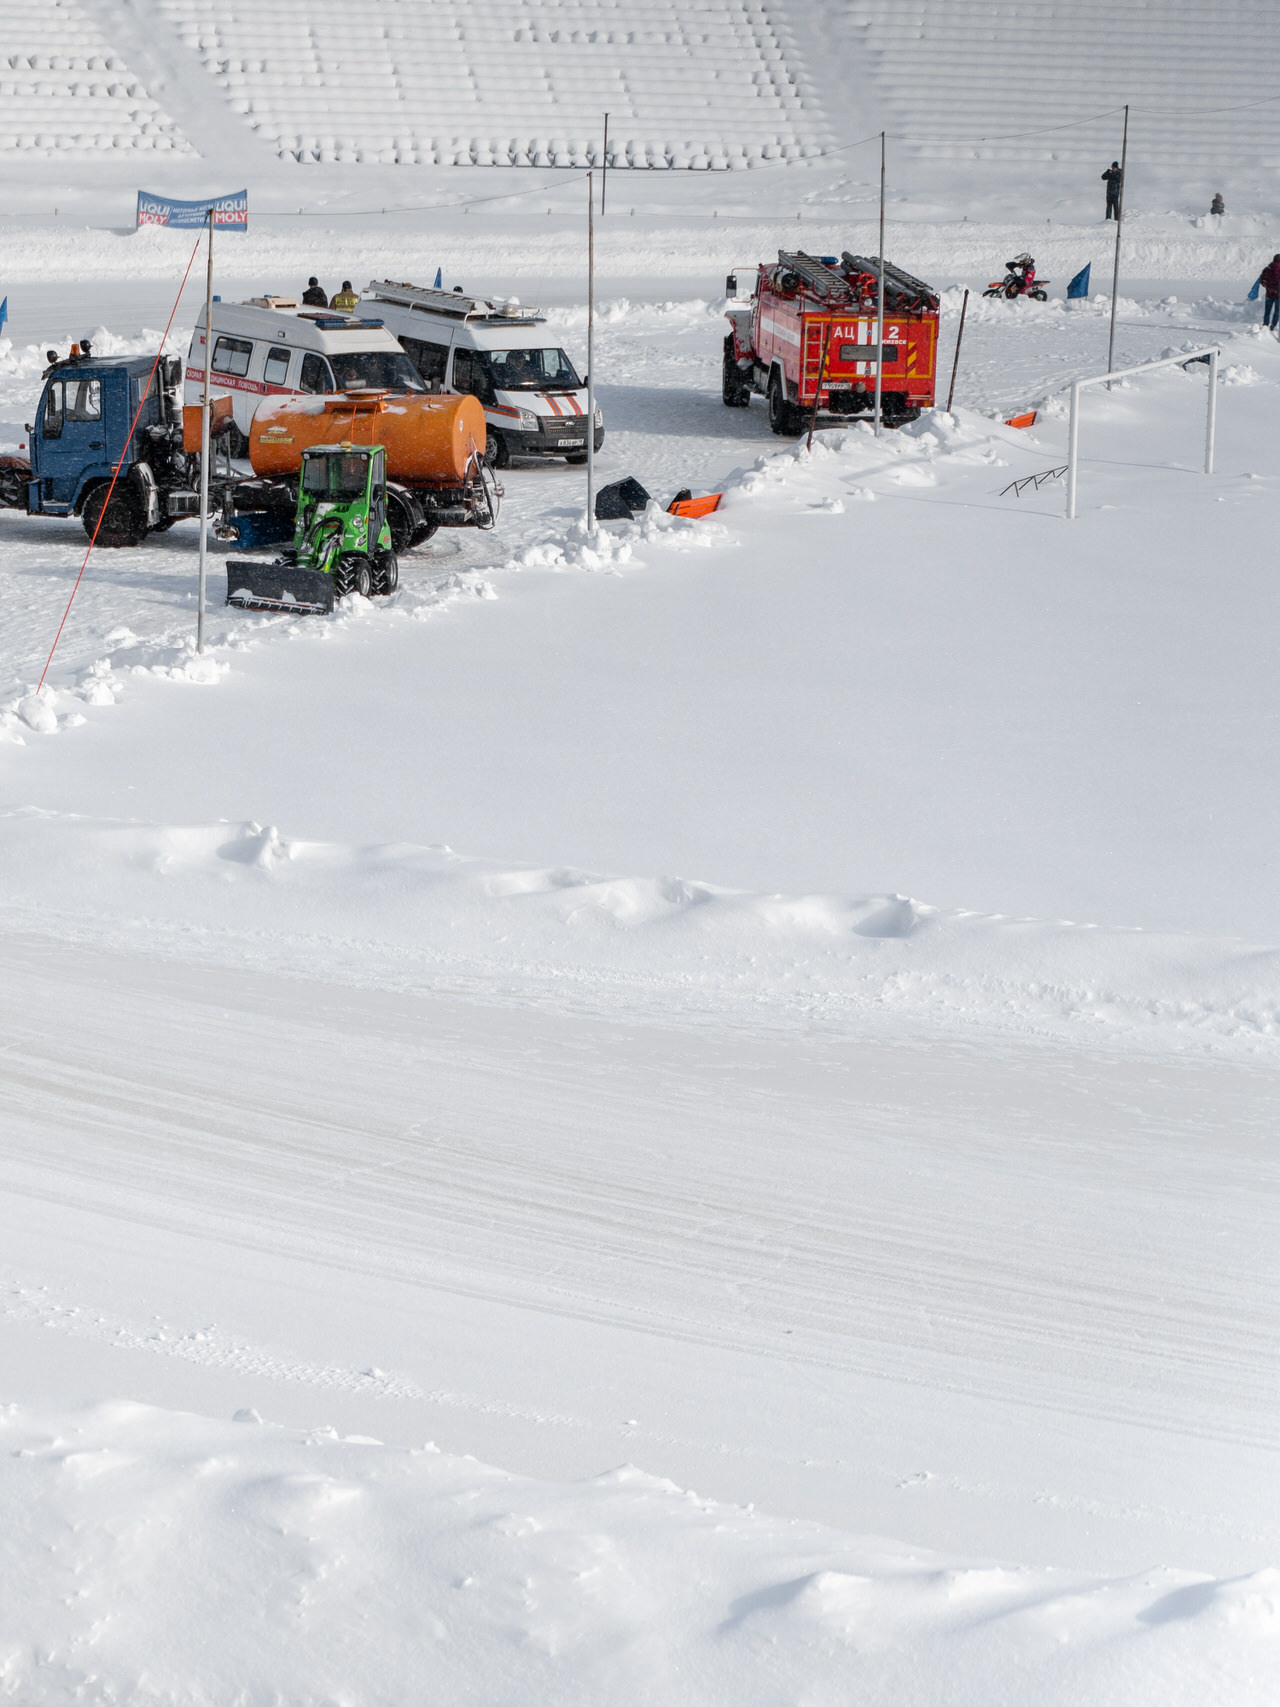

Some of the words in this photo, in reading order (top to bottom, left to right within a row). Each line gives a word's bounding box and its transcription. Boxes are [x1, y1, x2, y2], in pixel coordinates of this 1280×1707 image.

[140, 201, 170, 215] LIQUI
[216, 199, 246, 211] LIQUI
[140, 213, 167, 224] MOLY
[215, 211, 247, 223] MOLY
[833, 326, 855, 340] АЦ
[888, 326, 900, 339] 2
[238, 380, 258, 392] ПОМОЩЬ
